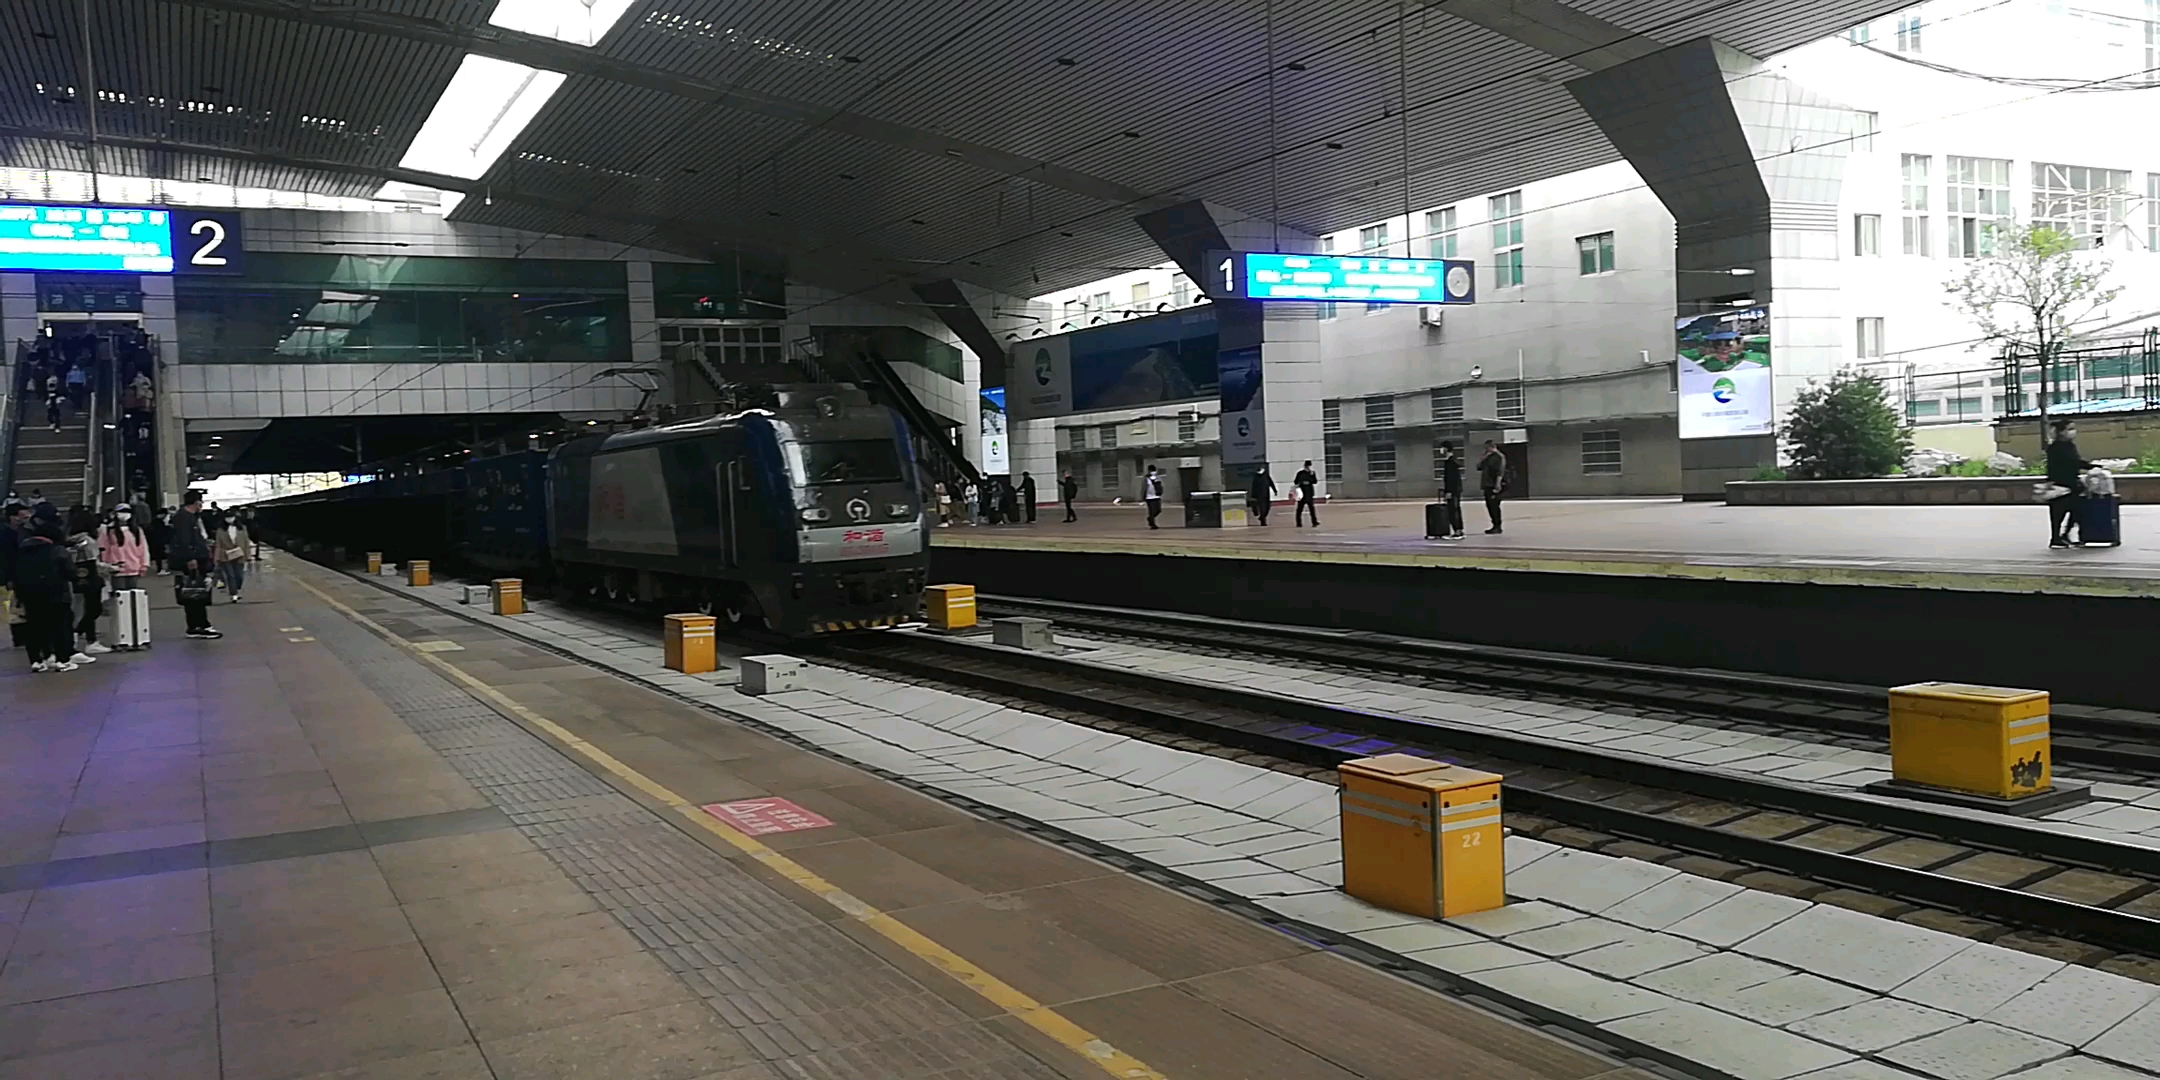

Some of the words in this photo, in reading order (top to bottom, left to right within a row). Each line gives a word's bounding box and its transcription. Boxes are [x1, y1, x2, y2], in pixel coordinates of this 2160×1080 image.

[190, 218, 227, 266] 2
[1219, 257, 1234, 292] 1
[1462, 831, 1481, 848] 22
